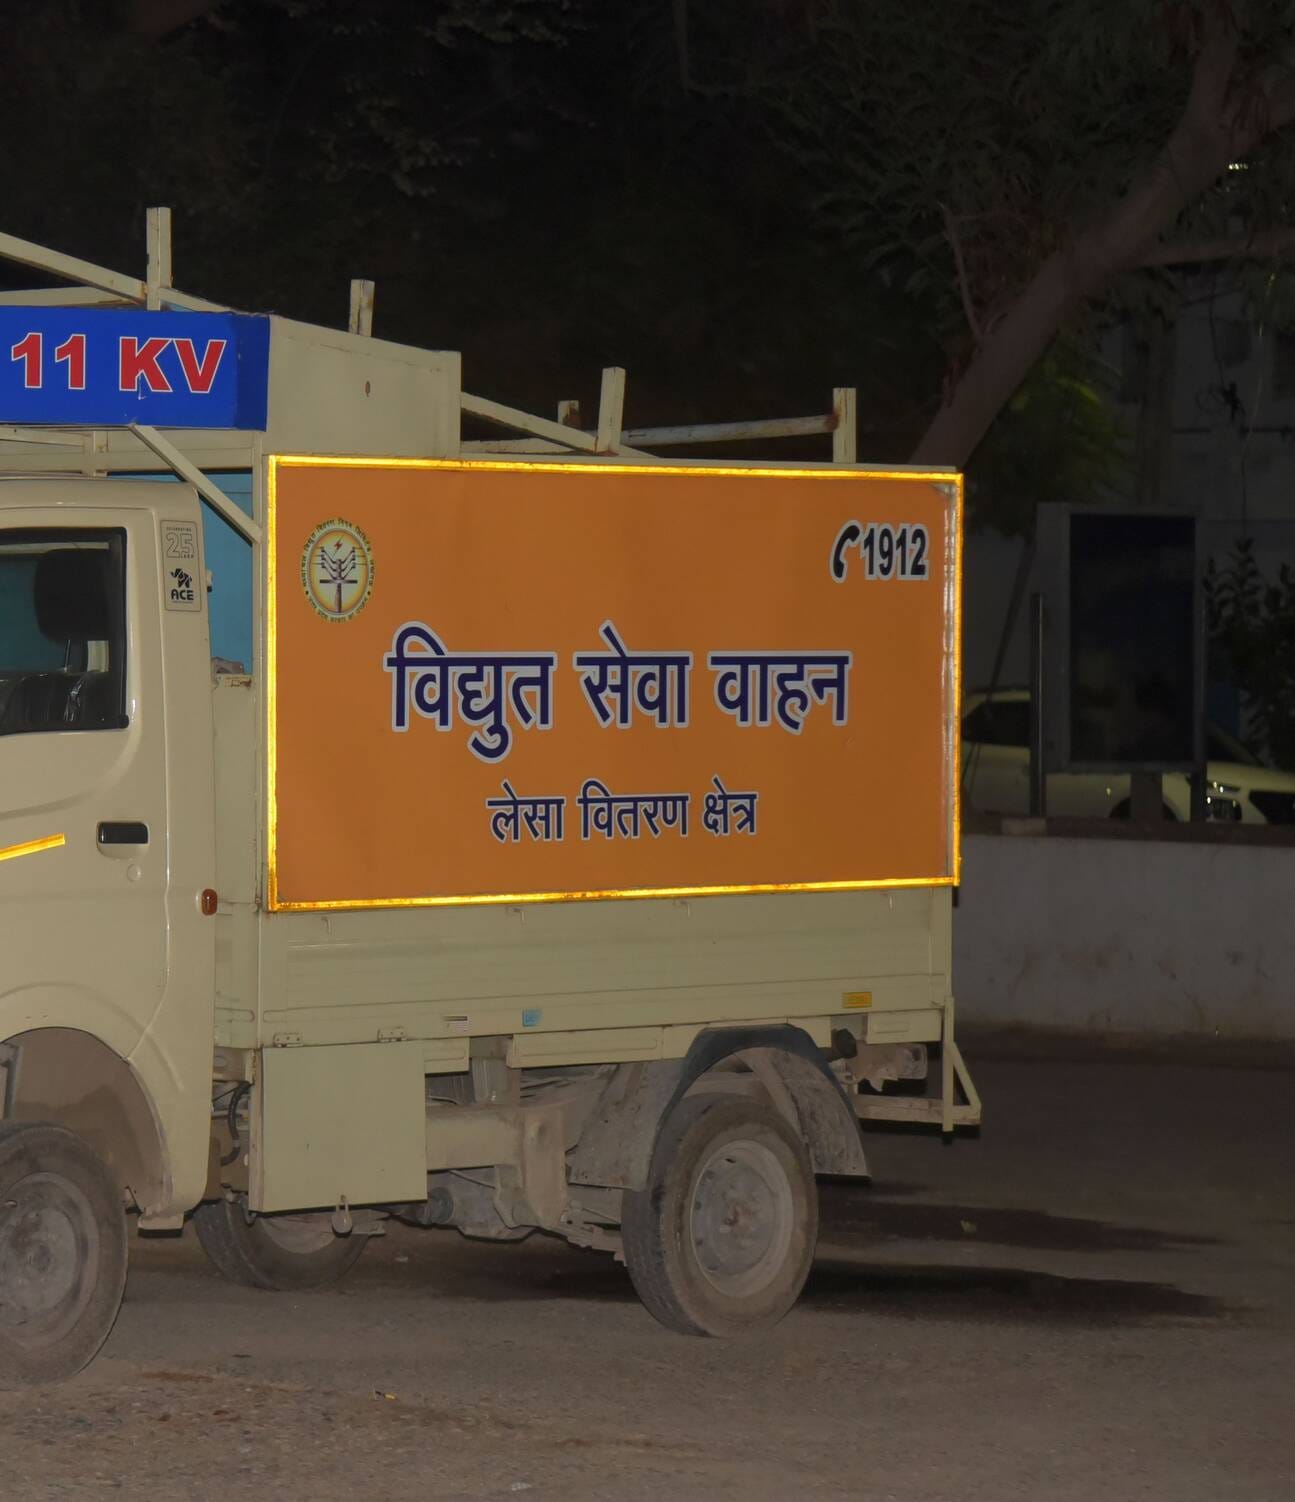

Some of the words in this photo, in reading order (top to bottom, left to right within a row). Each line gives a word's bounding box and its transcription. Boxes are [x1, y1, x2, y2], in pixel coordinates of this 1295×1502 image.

[11, 333, 85, 389] 11
[119, 337, 225, 392] KV
[861, 525, 930, 580] 1912
[170, 589, 195, 601] ACE
[384, 623, 556, 762] विद्युत
[574, 621, 693, 727] सेवा
[708, 652, 852, 734] वाहन
[486, 781, 565, 841] लेसा
[578, 779, 690, 840] वितरण
[702, 776, 758, 836] क्षेत्र
